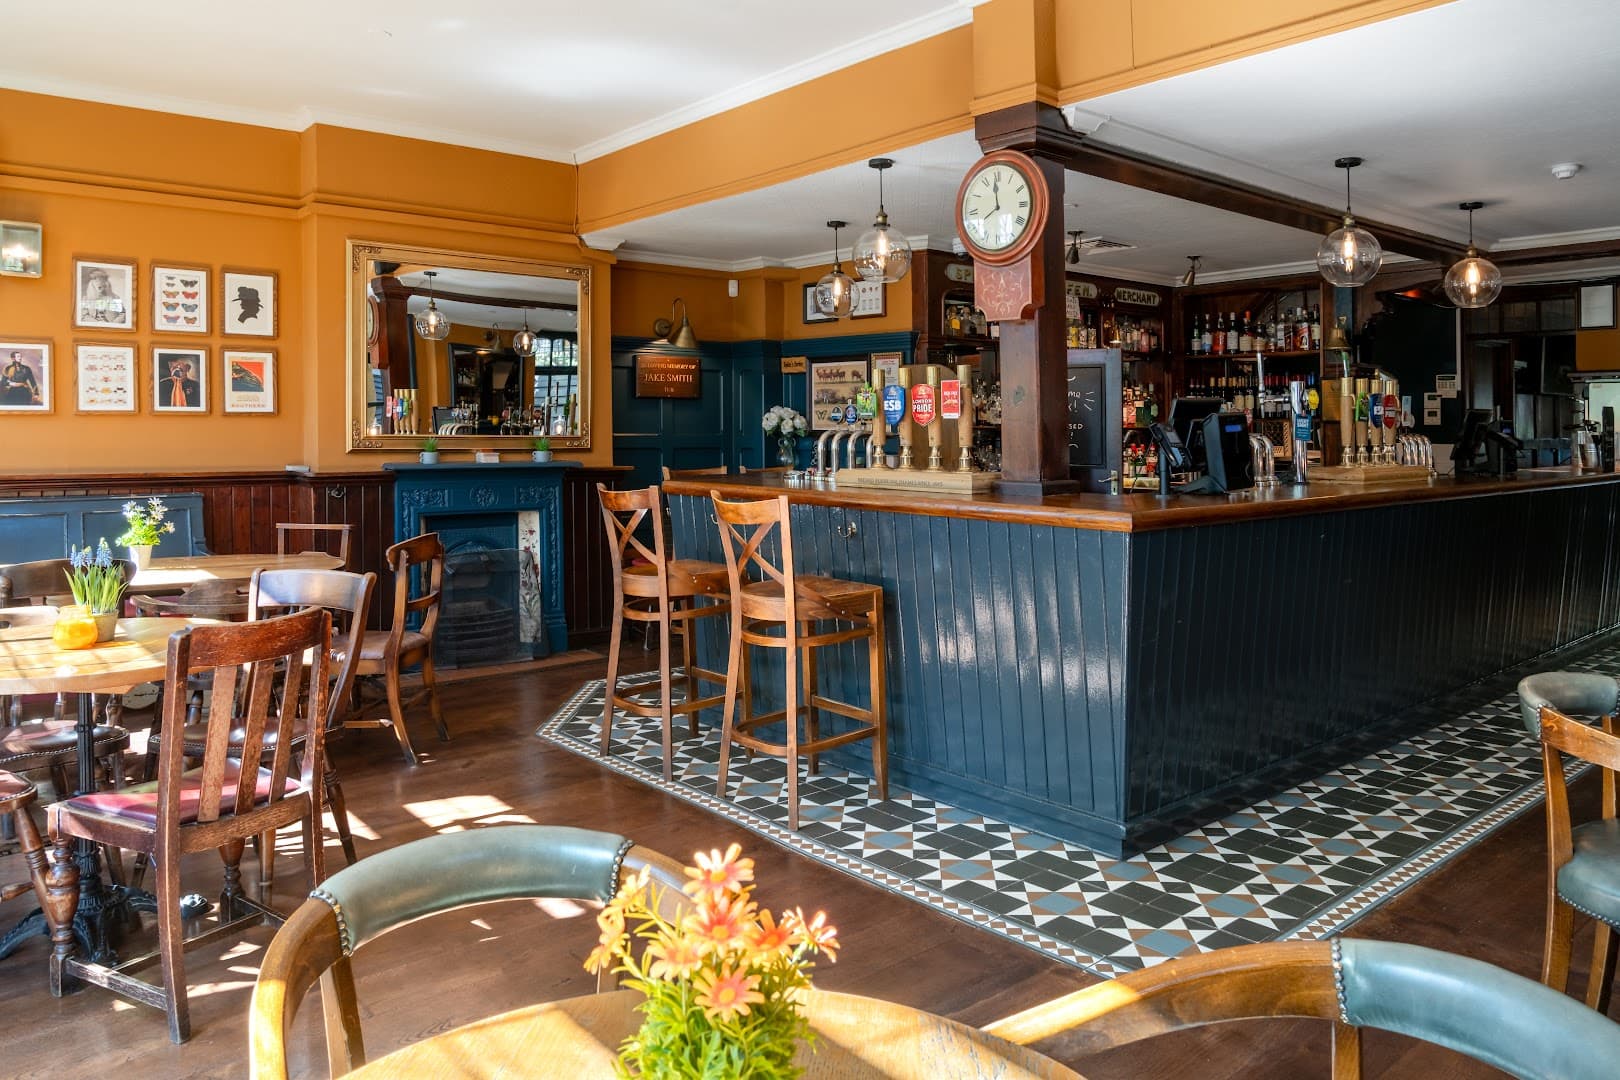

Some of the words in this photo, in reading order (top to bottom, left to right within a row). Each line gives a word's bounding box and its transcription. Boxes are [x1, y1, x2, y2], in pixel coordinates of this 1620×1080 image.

[956, 268, 971, 281] SP
[1116, 288, 1157, 305] MERCHANT
[645, 373, 665, 382] JAKE
[666, 373, 693, 383] SMITH
[883, 400, 902, 412] ESB
[913, 404, 933, 413] PRIDE
